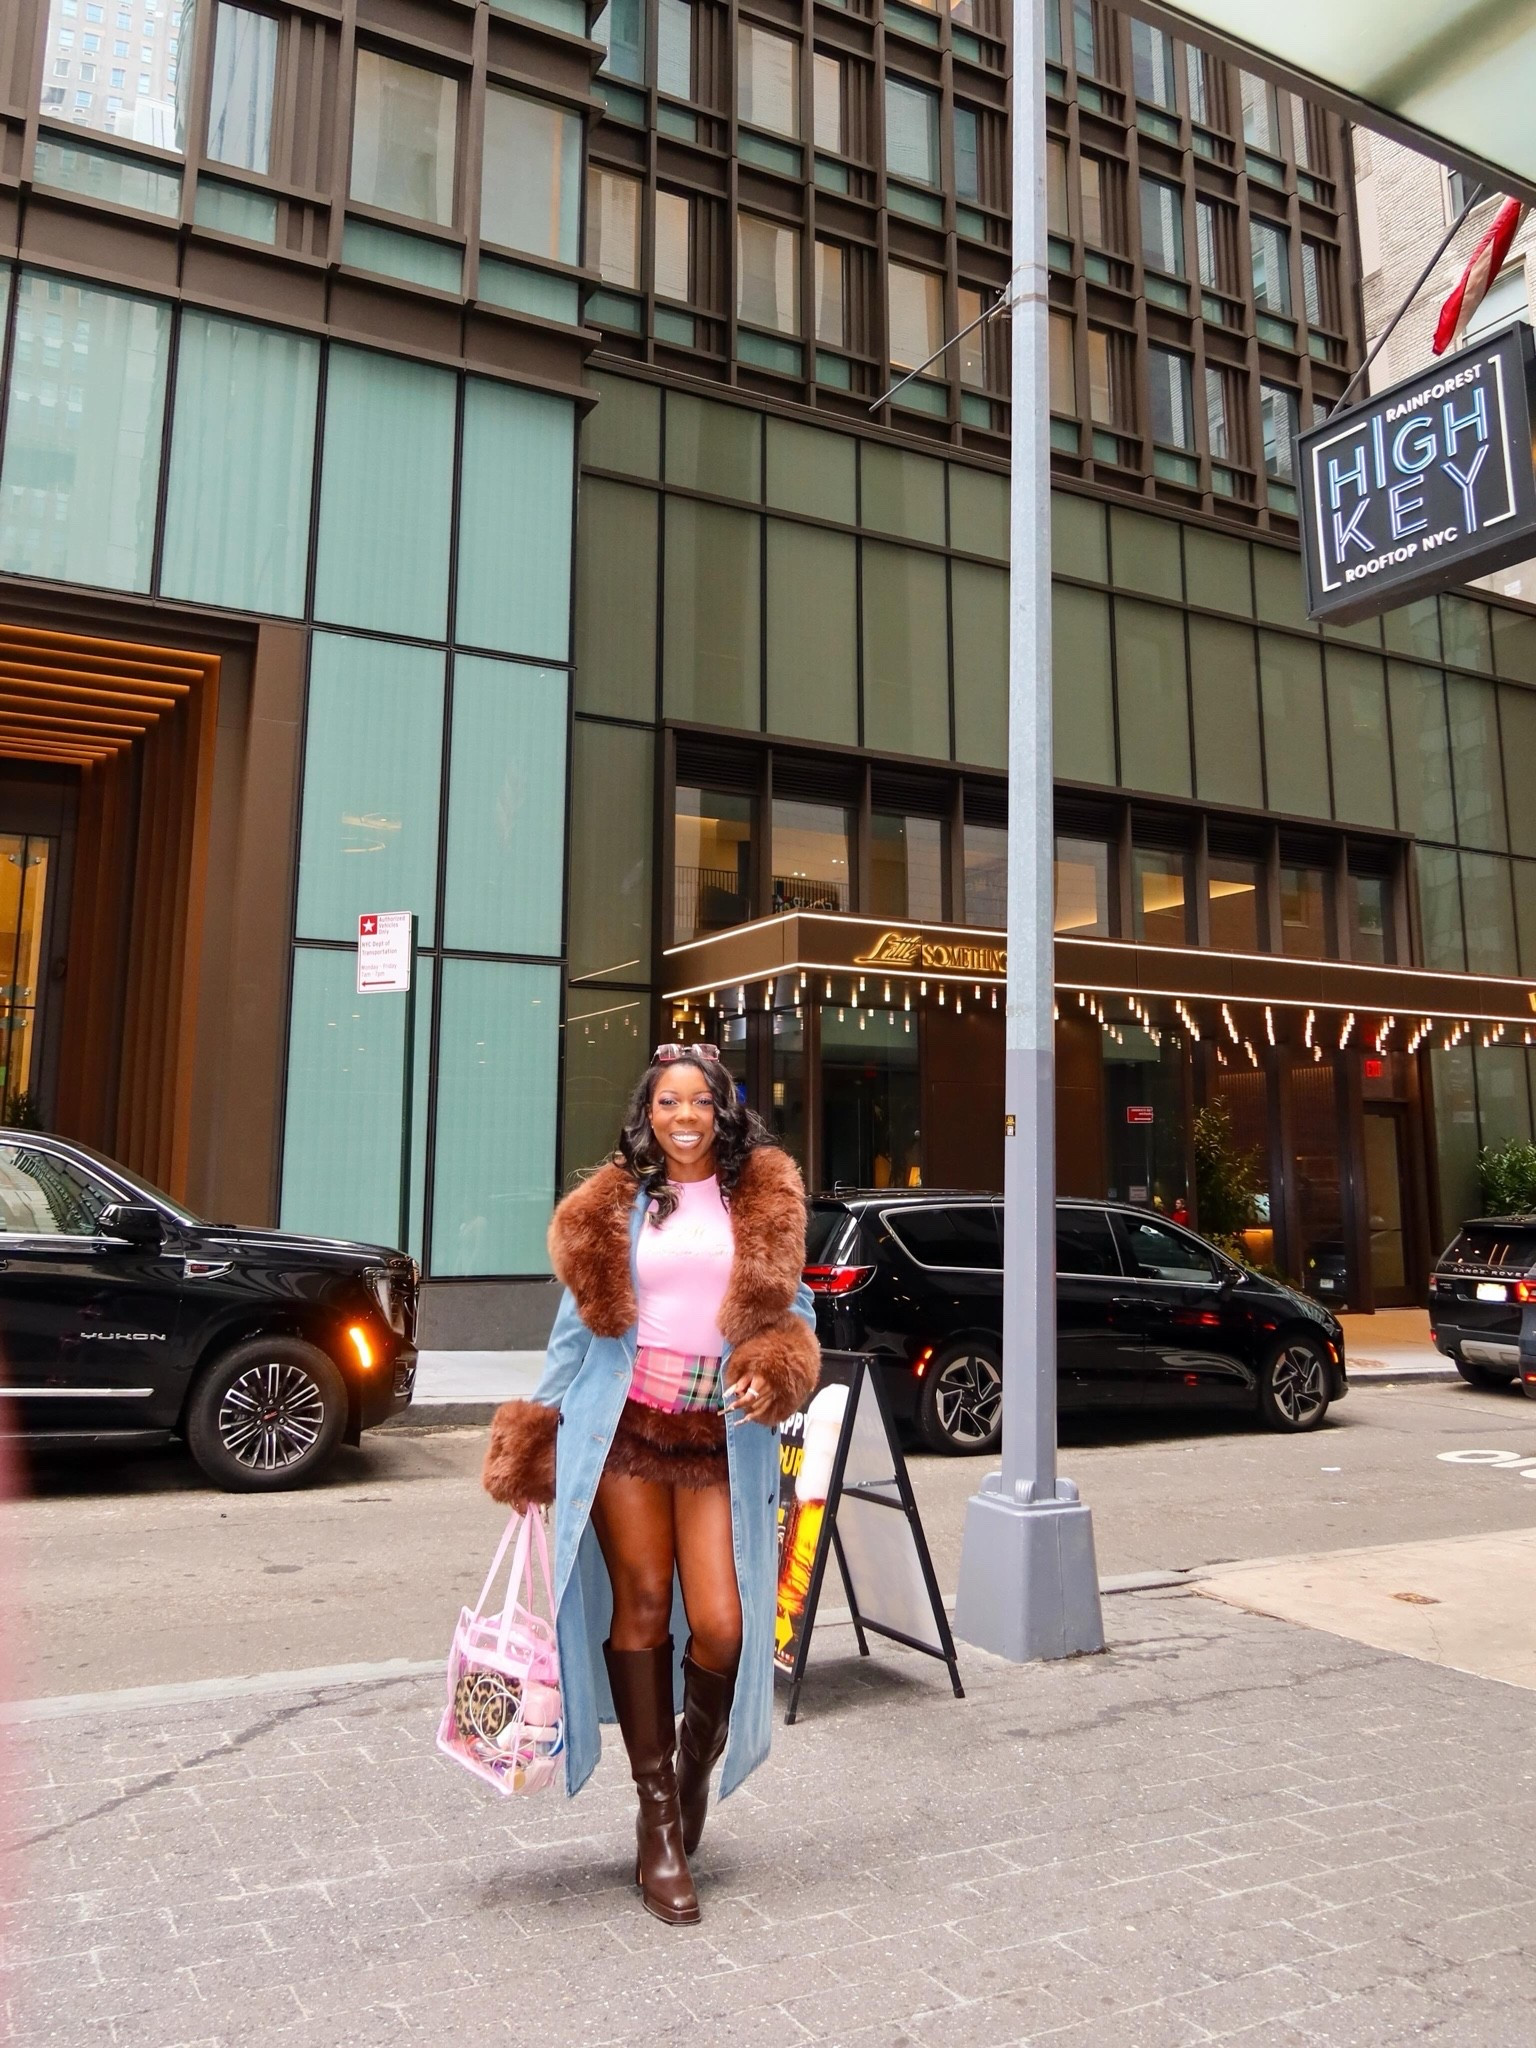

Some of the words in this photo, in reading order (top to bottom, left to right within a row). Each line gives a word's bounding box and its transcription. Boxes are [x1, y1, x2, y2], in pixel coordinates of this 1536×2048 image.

[1386, 363, 1482, 422] RAINFOREST
[1328, 387, 1488, 510] HIGH
[1332, 444, 1490, 564] KEY
[1345, 543, 1418, 583] ROOFTOP
[1422, 527, 1458, 552] NYC
[854, 931, 922, 966] Little
[80, 1332, 166, 1341] YUKON
